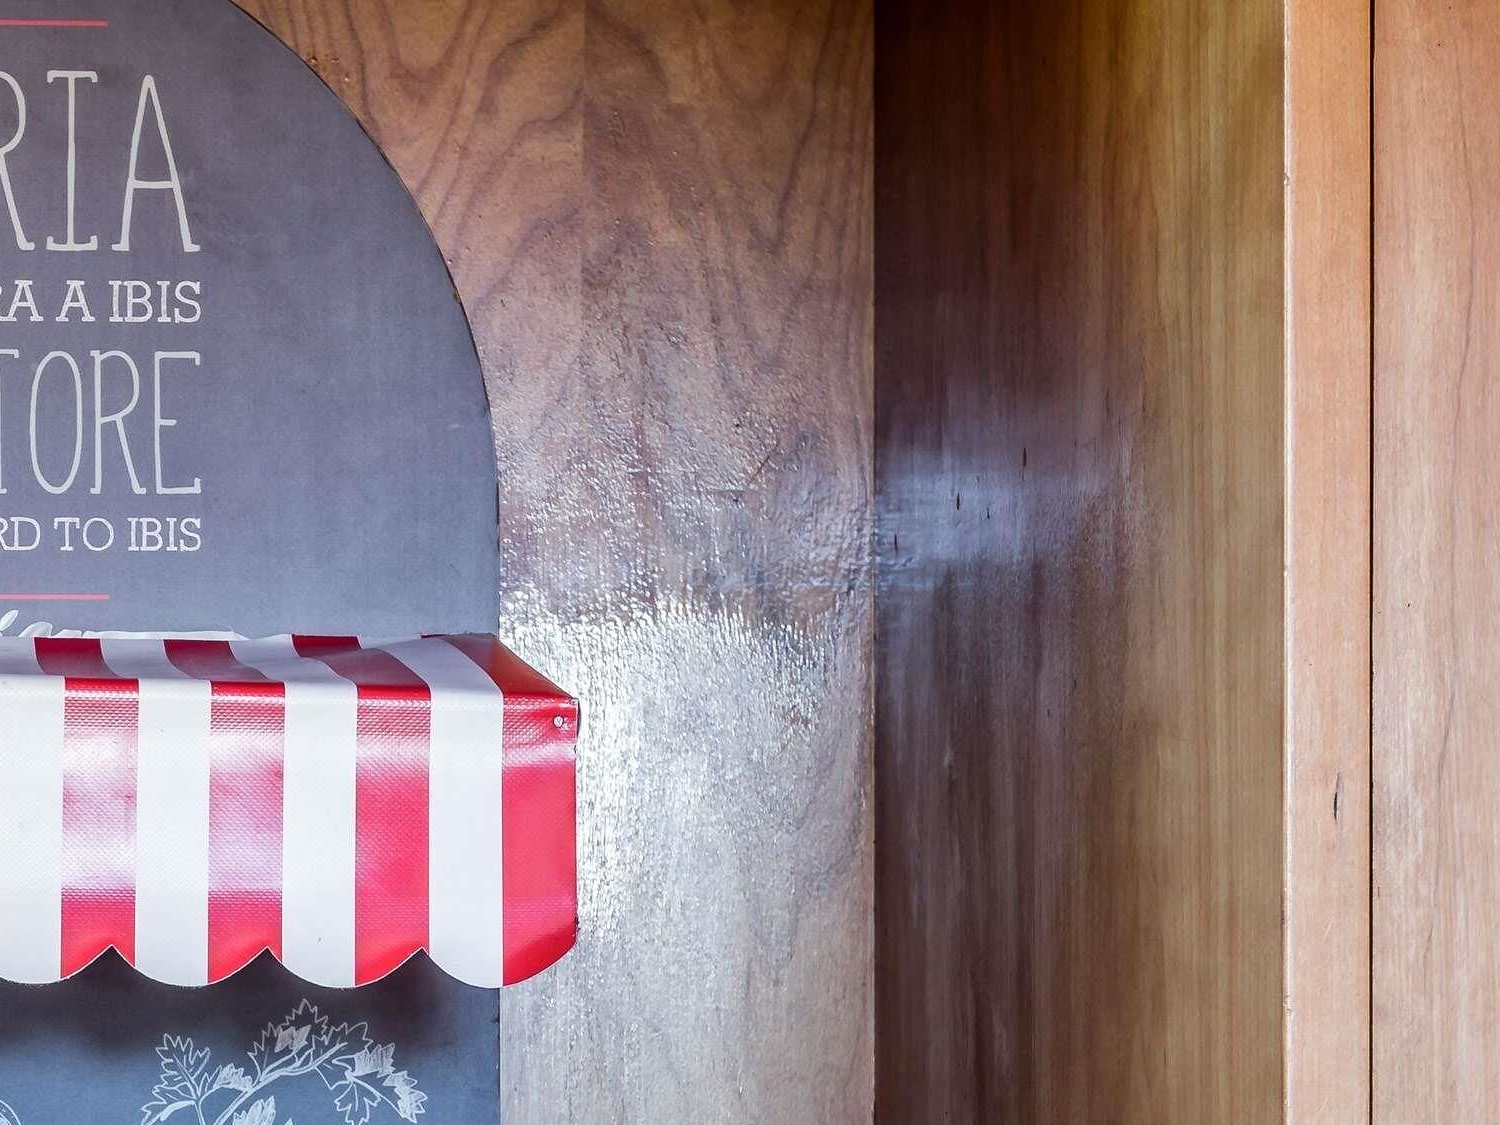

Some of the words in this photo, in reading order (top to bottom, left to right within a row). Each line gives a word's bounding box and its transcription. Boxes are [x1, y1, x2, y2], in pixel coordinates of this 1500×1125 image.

[56, 280, 94, 322] A
[109, 280, 201, 323] IBIS
[53, 517, 114, 551] TO
[128, 517, 201, 551] IBIS
